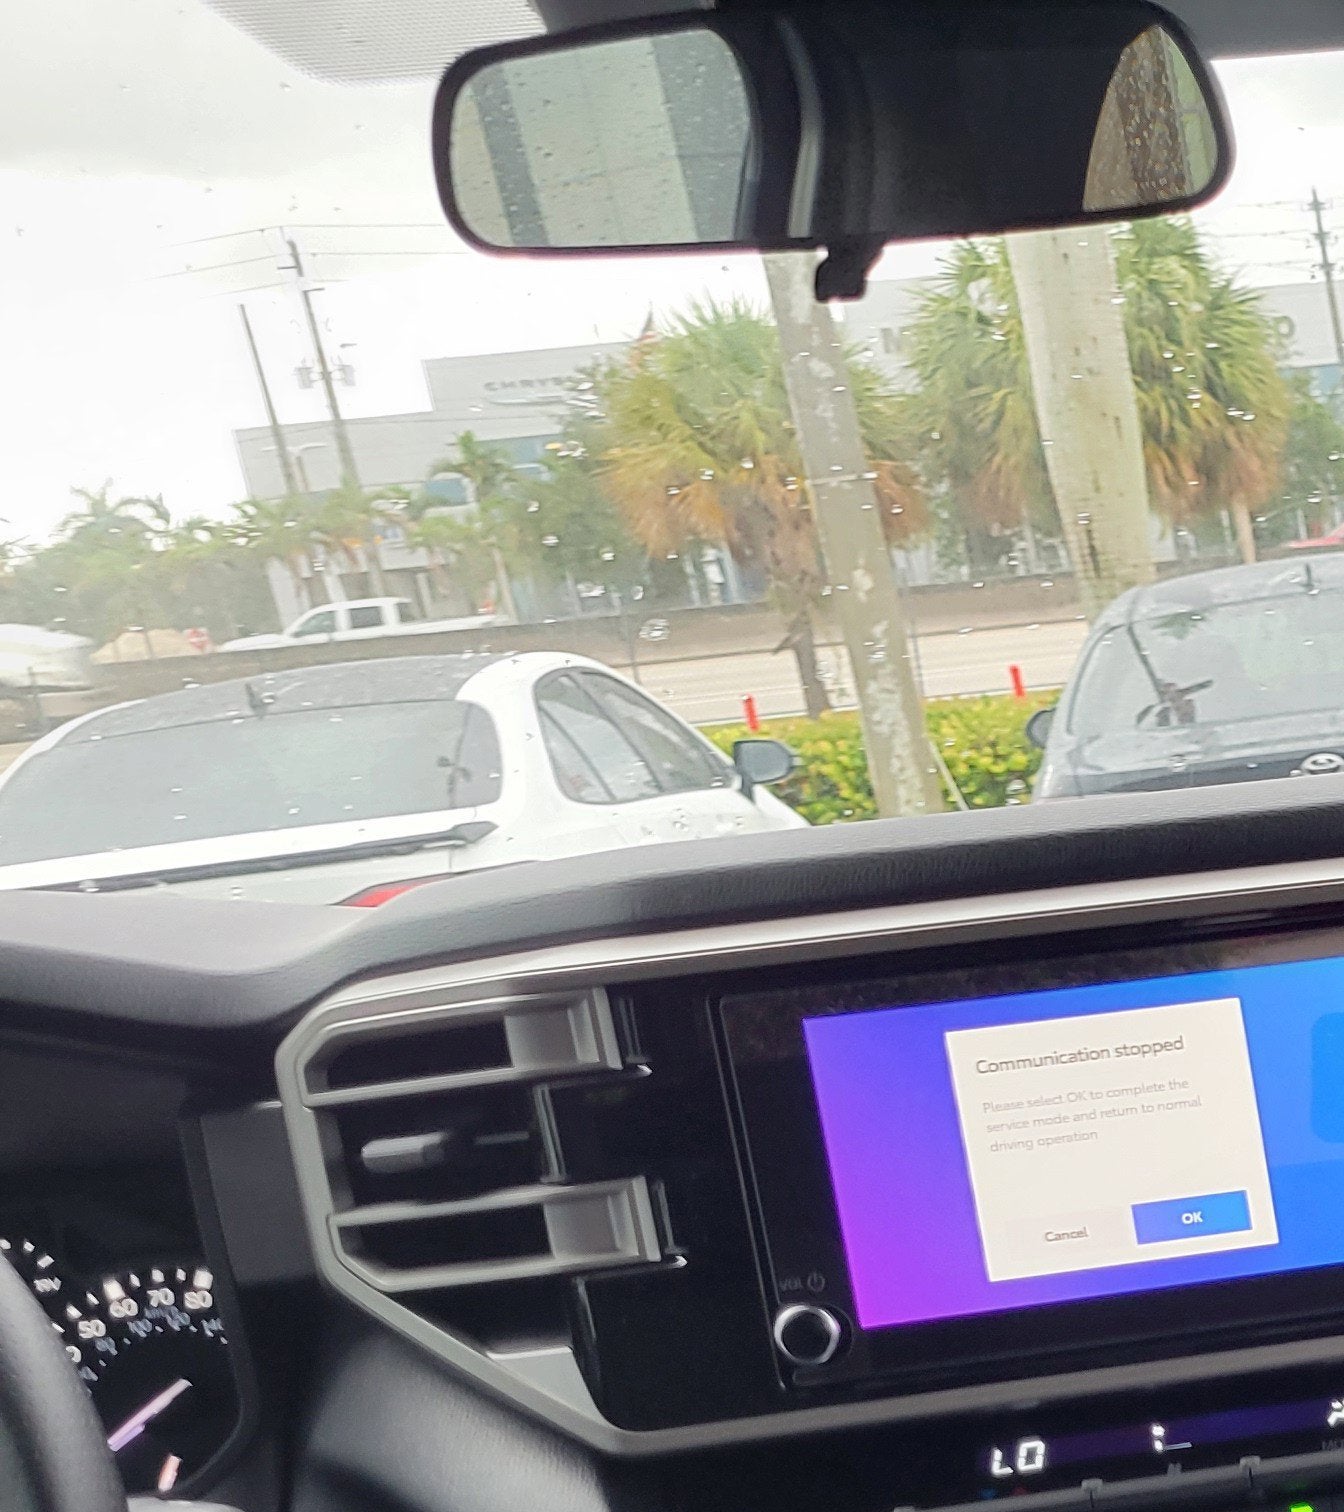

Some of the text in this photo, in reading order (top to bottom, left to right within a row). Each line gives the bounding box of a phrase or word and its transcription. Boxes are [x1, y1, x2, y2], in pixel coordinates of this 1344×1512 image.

[975, 1036, 1185, 1075] Communication stopped
[982, 1078, 1190, 1114] Please select OK to complete the
[986, 1095, 1202, 1133] service mode and return to normal
[990, 1129, 1099, 1153] driving operation
[1181, 1211, 1204, 1225] OK
[1044, 1226, 1089, 1242] Cancel
[146, 1287, 176, 1308] 70
